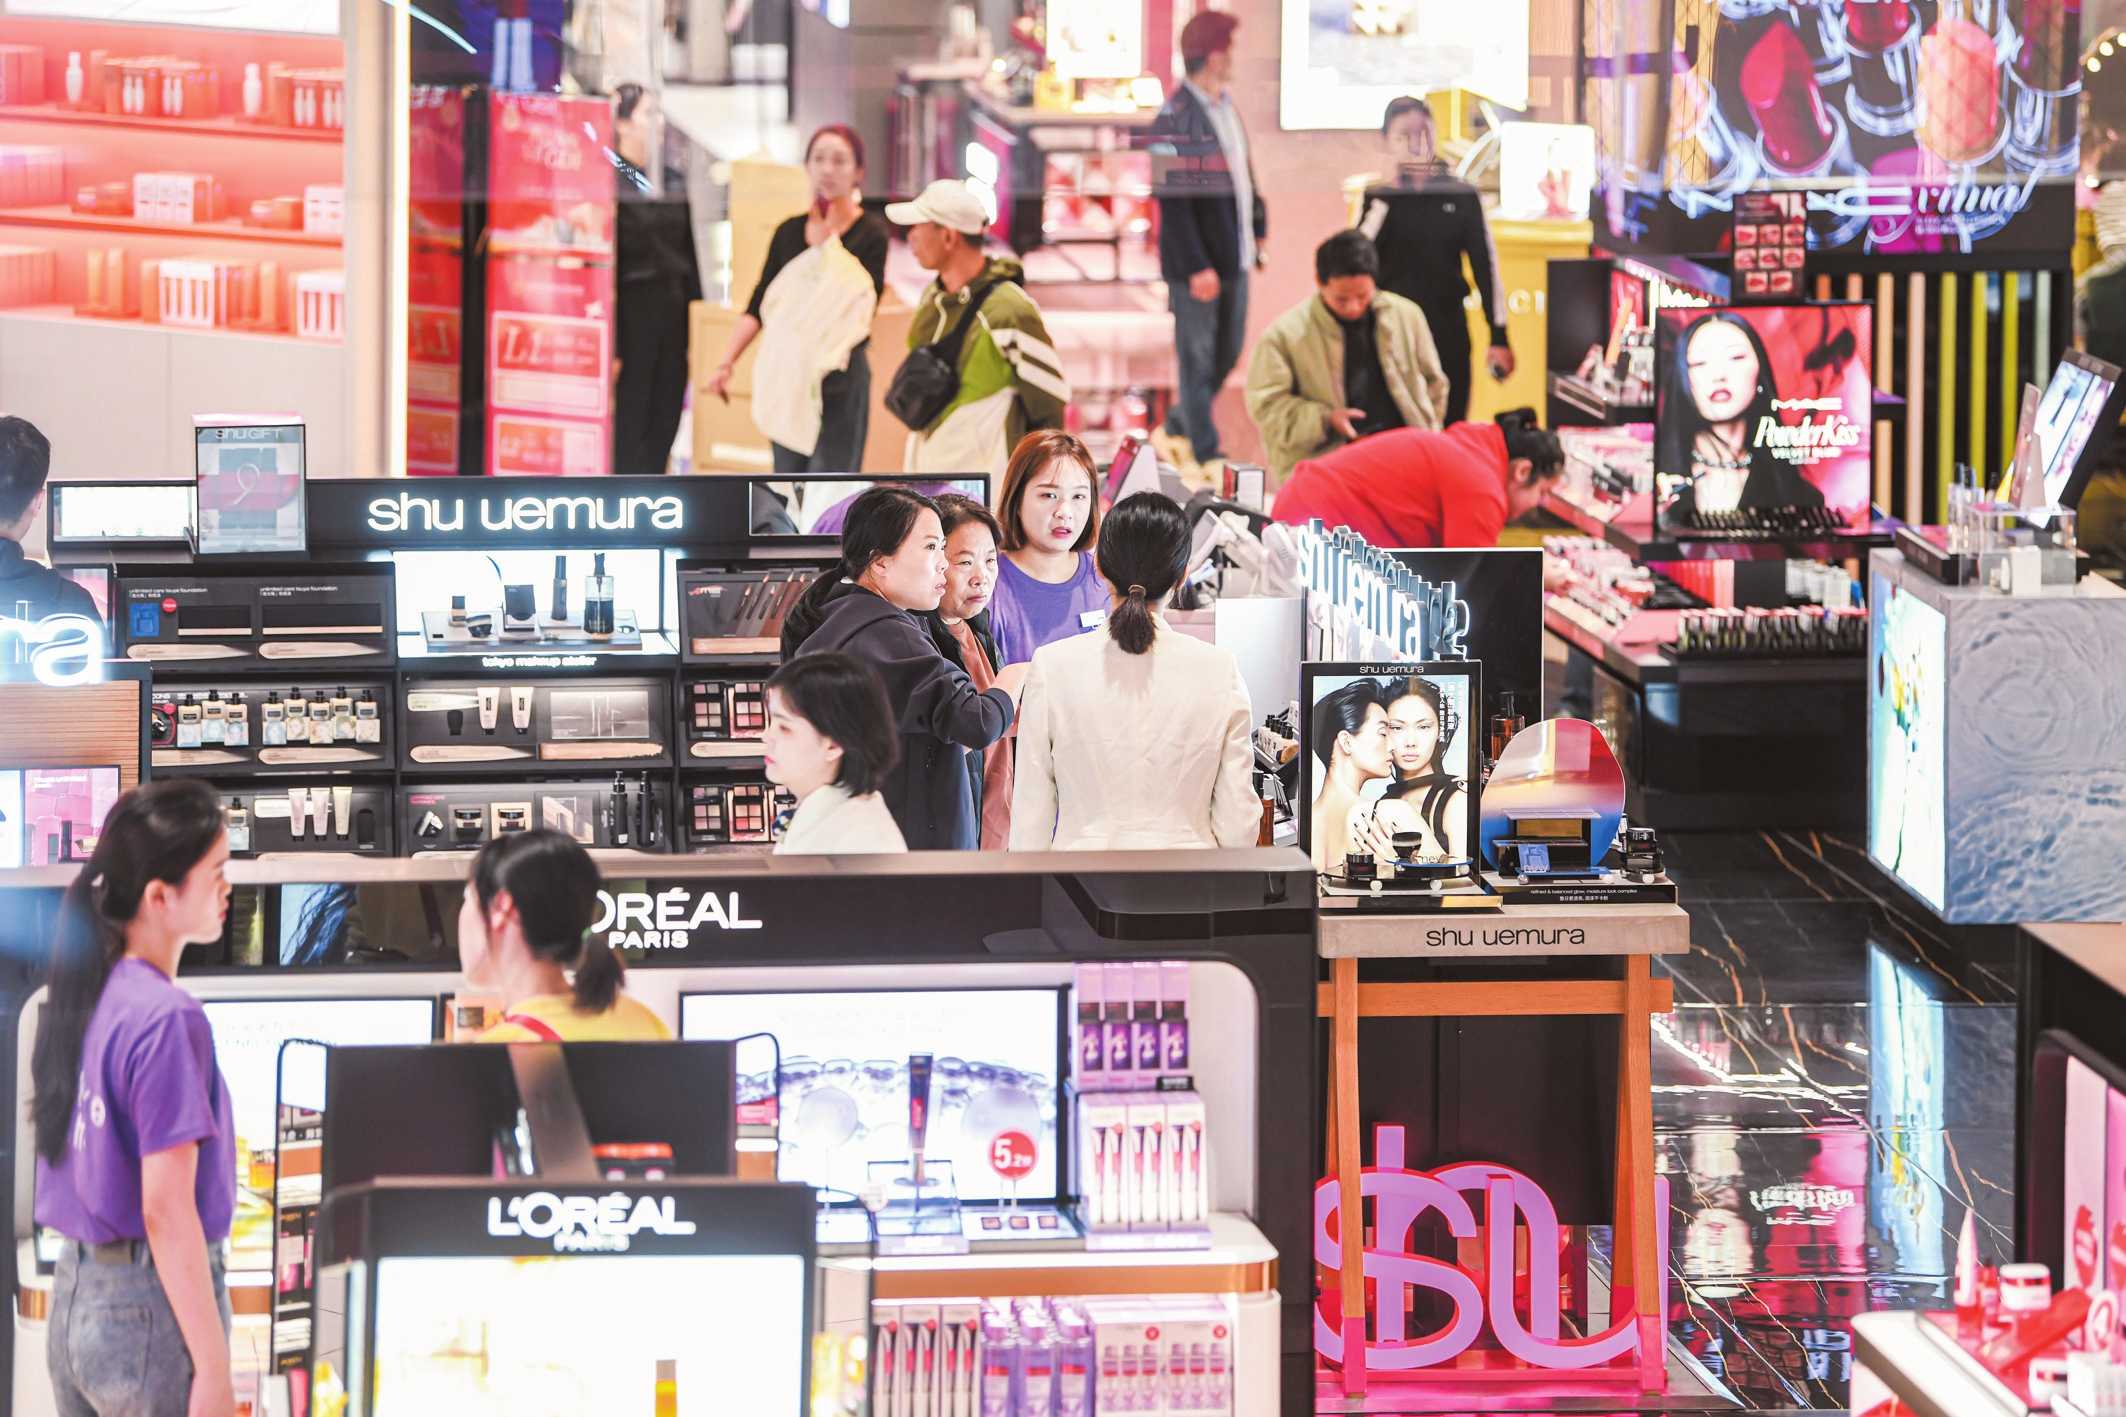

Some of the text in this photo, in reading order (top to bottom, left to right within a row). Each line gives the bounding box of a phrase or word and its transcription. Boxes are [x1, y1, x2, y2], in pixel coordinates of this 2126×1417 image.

[367, 492, 683, 531] shu uemura
[1337, 549, 1421, 662] uemura
[515, 656, 561, 668] makeup
[1360, 665, 1424, 674] shu uemura
[608, 930, 689, 949] PARIS
[1426, 927, 1585, 946] shu uemura
[488, 1191, 696, 1239] L'ORÉAL
